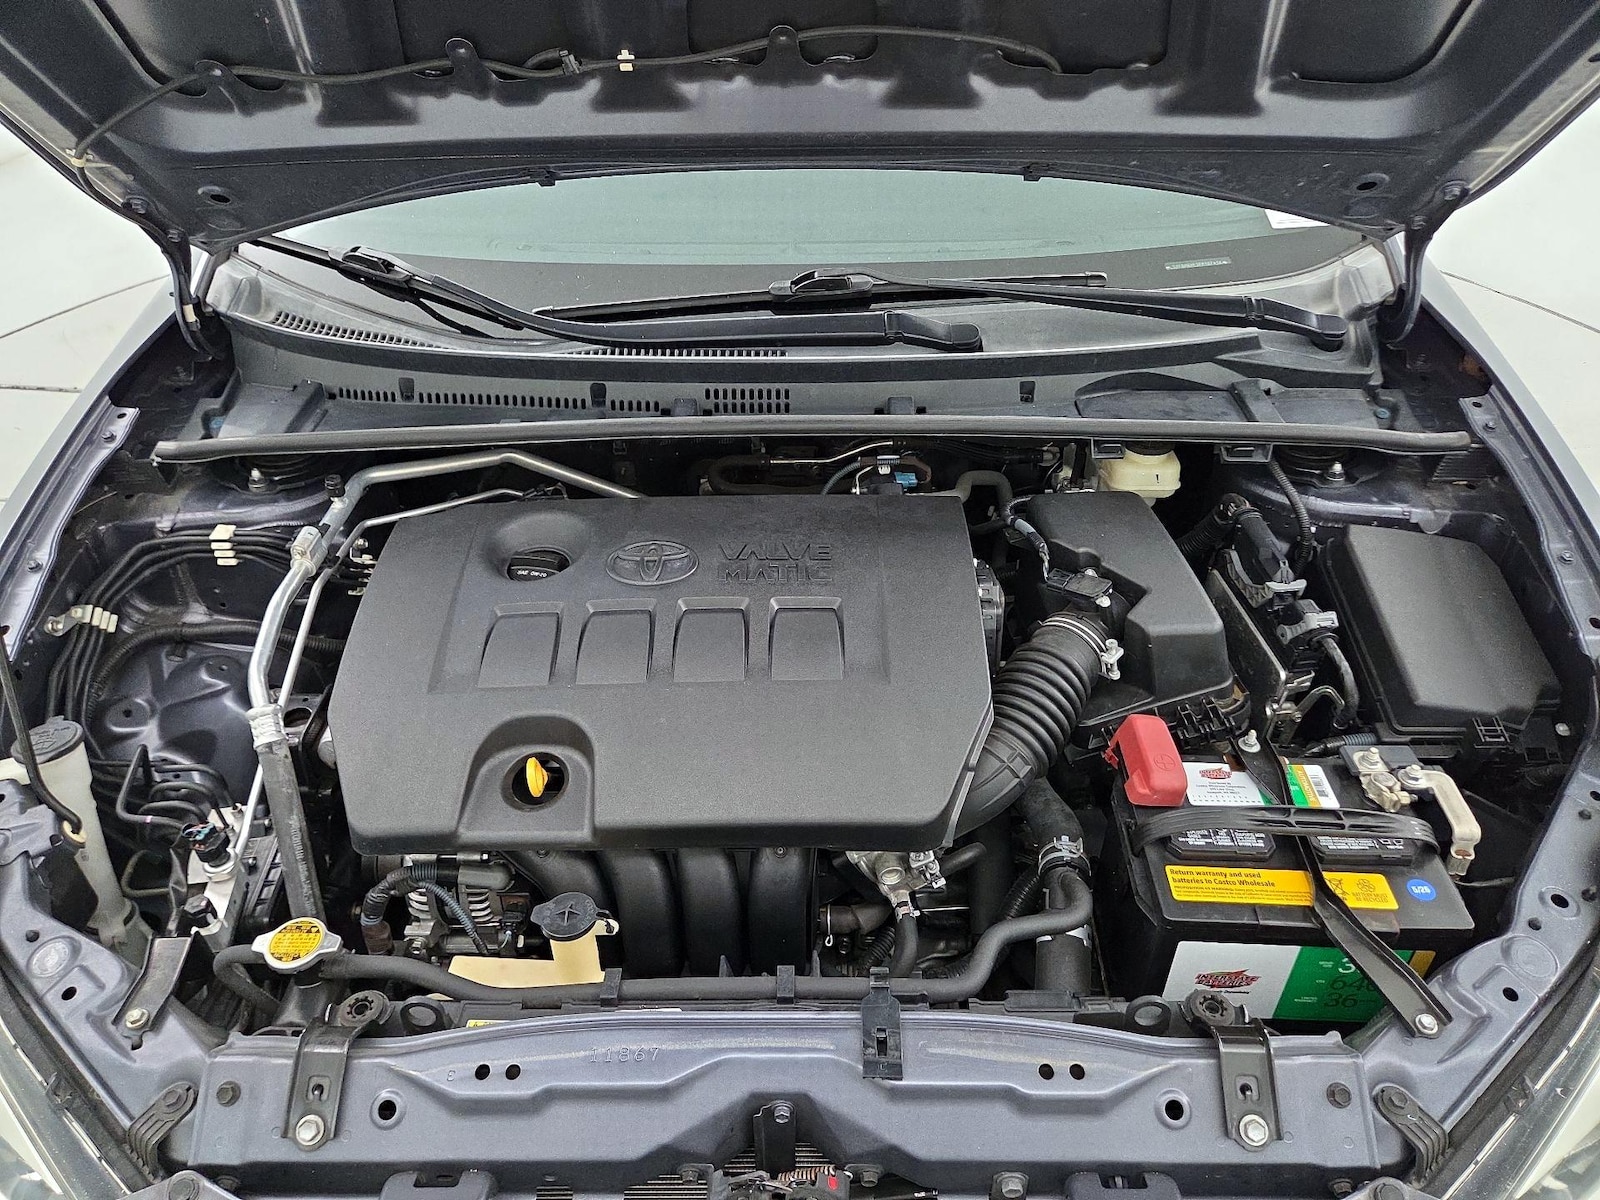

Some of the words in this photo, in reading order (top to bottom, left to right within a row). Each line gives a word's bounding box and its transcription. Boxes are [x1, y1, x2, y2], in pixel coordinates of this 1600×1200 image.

[718, 543, 833, 561] VALVE
[718, 562, 833, 581] MATIC
[1169, 868, 1194, 876] Return
[1171, 876, 1204, 884] batteries
[1238, 879, 1276, 888] Wholesale
[589, 1046, 660, 1063] 11867
